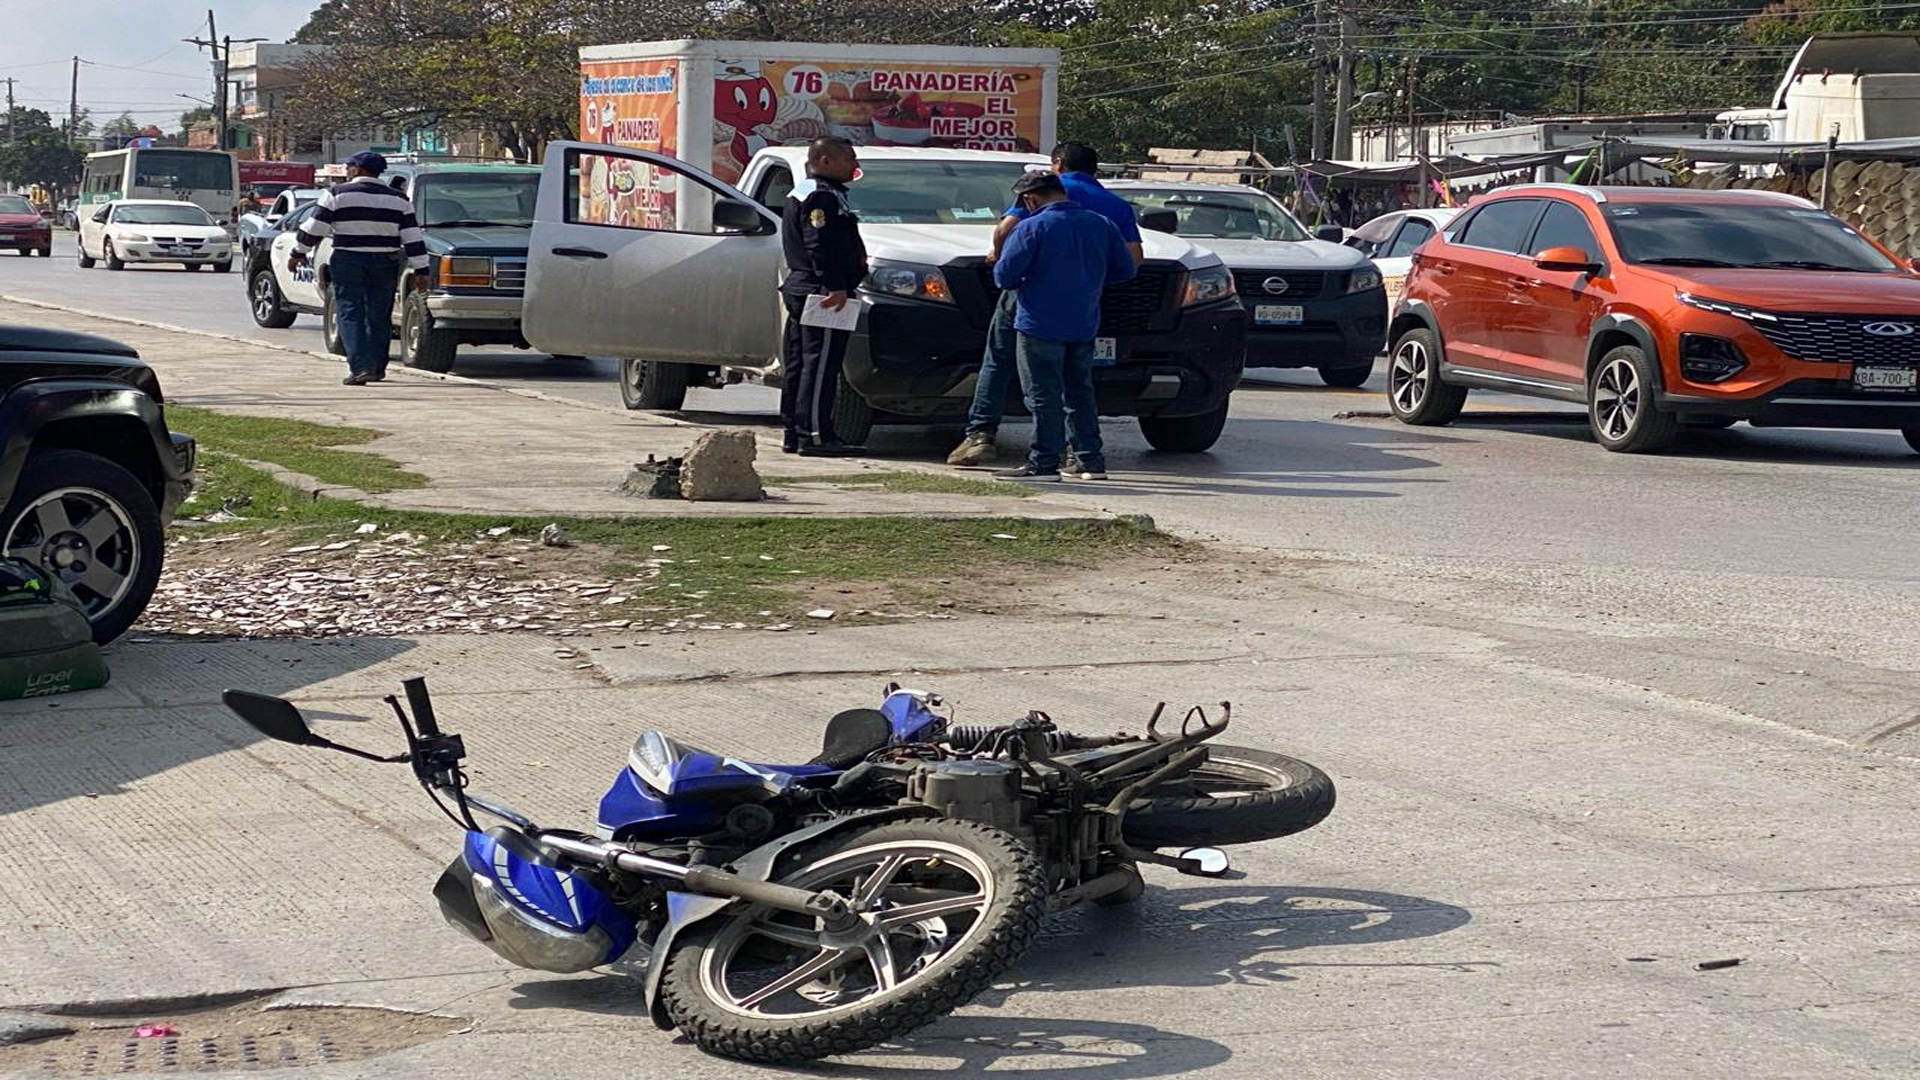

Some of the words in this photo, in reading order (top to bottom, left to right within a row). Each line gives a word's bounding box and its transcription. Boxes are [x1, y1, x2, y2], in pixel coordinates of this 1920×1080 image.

[791, 71, 823, 94] 76
[873, 70, 1016, 93] PANADERÍA
[986, 97, 1015, 114] EL
[932, 118, 1015, 137] MEJOR
[966, 141, 1014, 152] PAN
